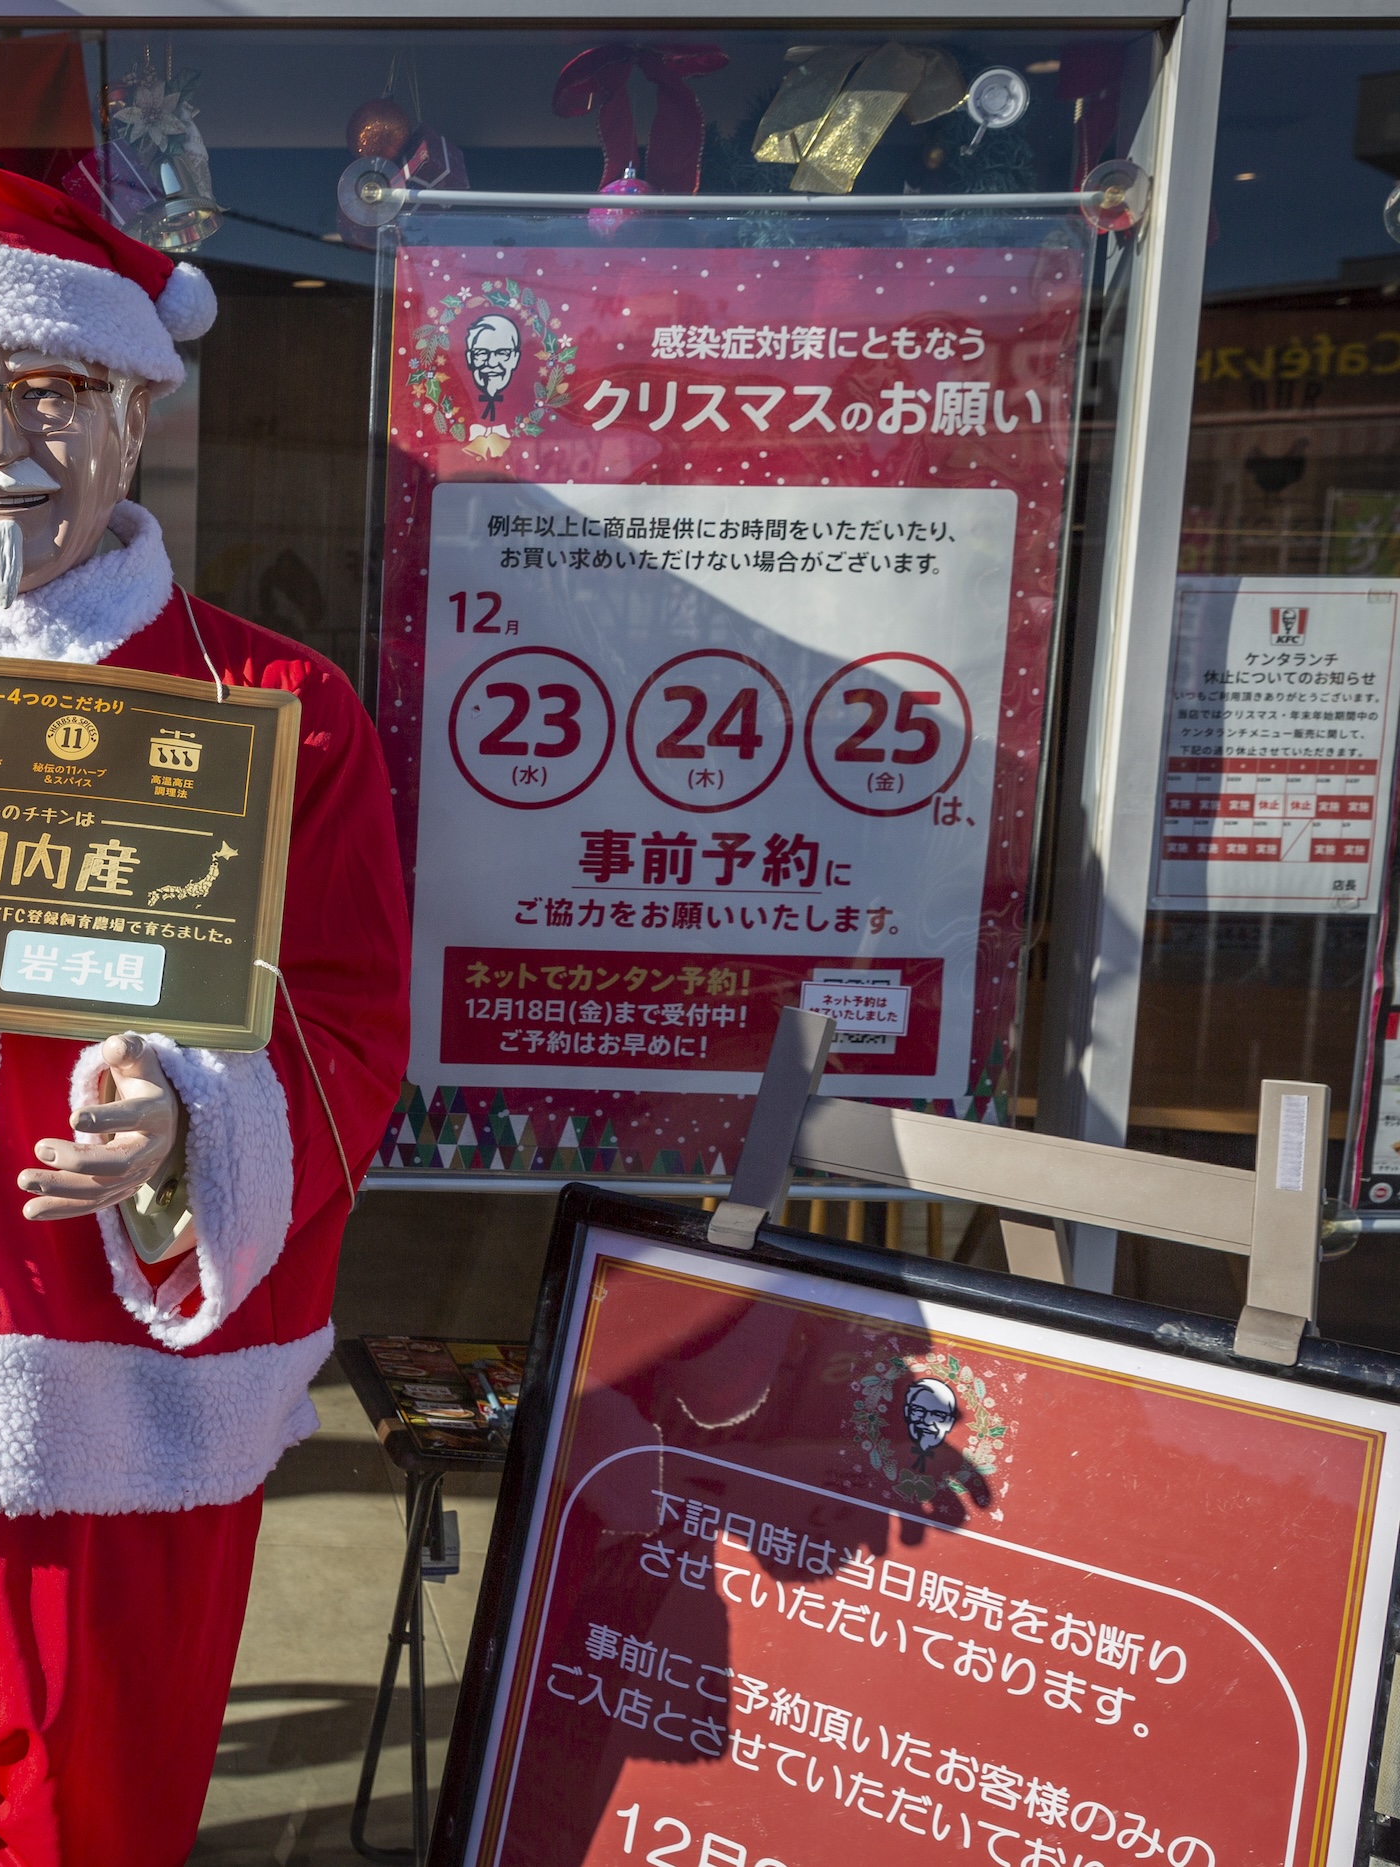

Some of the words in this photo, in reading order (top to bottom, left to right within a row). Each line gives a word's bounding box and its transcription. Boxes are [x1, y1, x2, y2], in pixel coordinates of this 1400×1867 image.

[651, 325, 986, 361] 感染症対策にともなう
[583, 380, 1042, 437] クリスマスのお願い
[487, 515, 957, 544] 例年以上に商品提供にお時間をいただいたり、
[499, 546, 942, 577] お買い求めいただけない場合がございます。
[448, 590, 520, 636] 12月
[1275, 635, 1300, 644] KFC
[1245, 652, 1339, 667] ケンタランチ
[1203, 669, 1376, 686] 休止についてのお知らせ
[50, 716, 71, 733] HERBS
[79, 718, 98, 738] SPICES
[478, 682, 582, 758] 23
[655, 685, 763, 760] 24
[833, 687, 942, 765] 25
[61, 726, 83, 749] 11
[32, 762, 108, 778] 秘伝の11ハーブ
[43, 775, 93, 788] &スパイス
[150, 774, 195, 790] 高温高圧
[511, 764, 548, 787] (水)
[687, 768, 725, 791] (木)
[866, 771, 904, 794] (金)
[153, 785, 188, 799] 調理法
[578, 829, 852, 887] 事前予約に
[1331, 879, 1357, 891] 店長
[514, 896, 900, 937] ご協力をお願いいたします。
[17, 943, 145, 992] 岩手県
[465, 961, 751, 996] ネットでカンタン予約!
[822, 994, 888, 1008] ネット予約は
[500, 1029, 707, 1059] ご予約はお早めに!
[651, 1488, 1188, 1684] 下記日時は当日販売をお断り
[639, 1540, 1149, 1738] させていただいております。
[584, 1622, 1216, 1867] 事前にご予約頂いたお客様のみの
